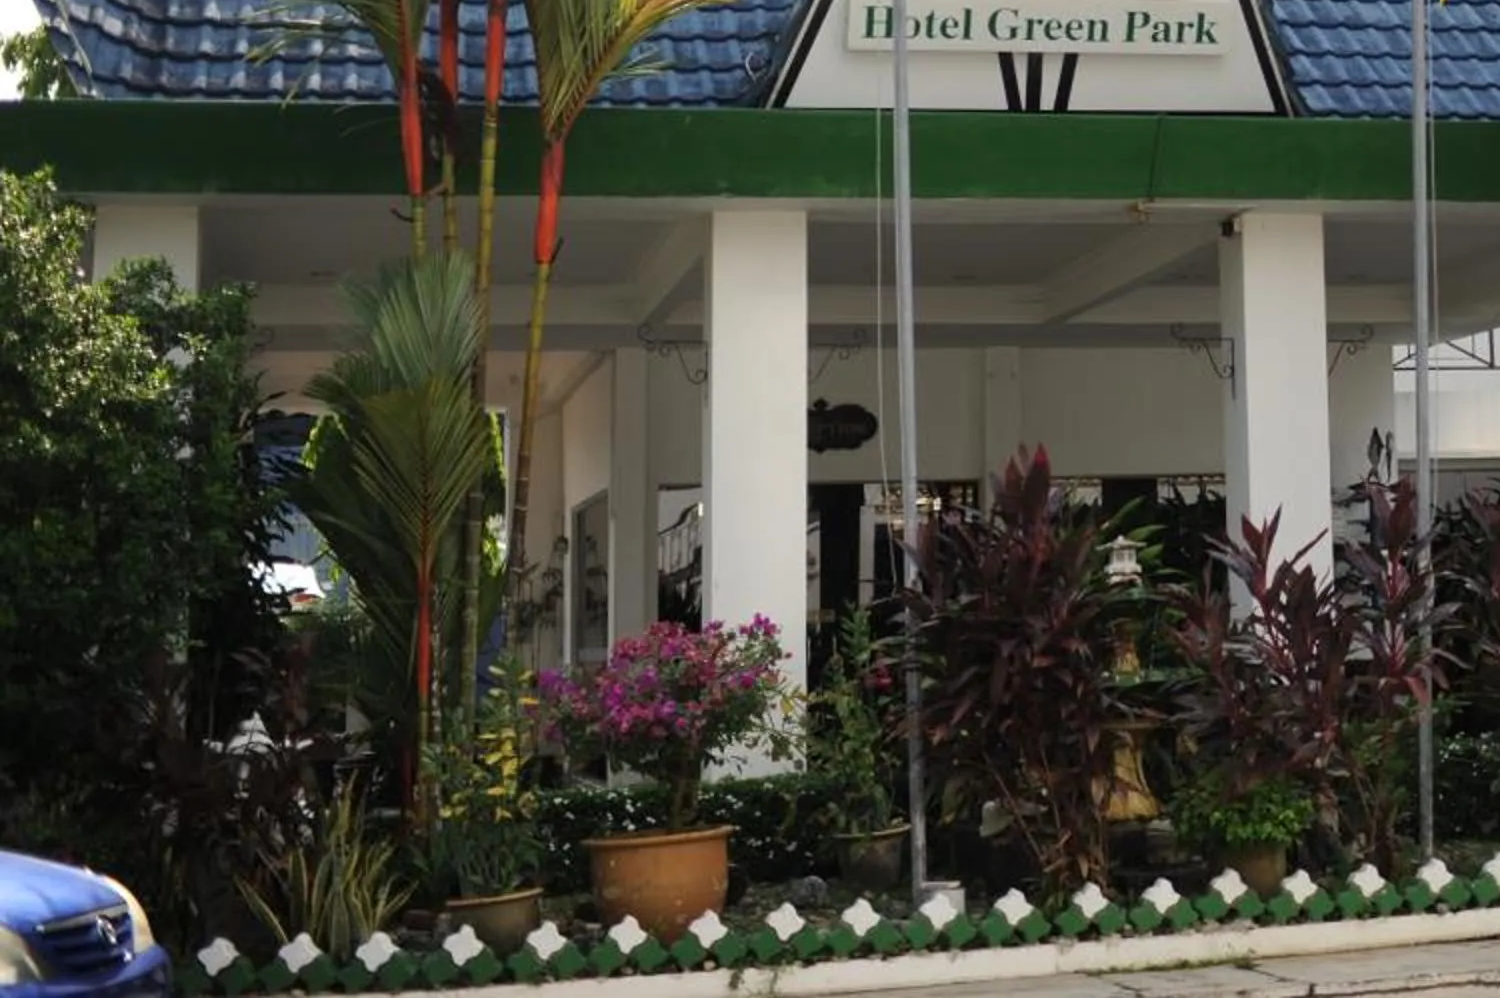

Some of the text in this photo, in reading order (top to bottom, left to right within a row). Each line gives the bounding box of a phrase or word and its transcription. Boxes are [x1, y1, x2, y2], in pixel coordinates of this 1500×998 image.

[862, 5, 1219, 45] Hotel Green Park
